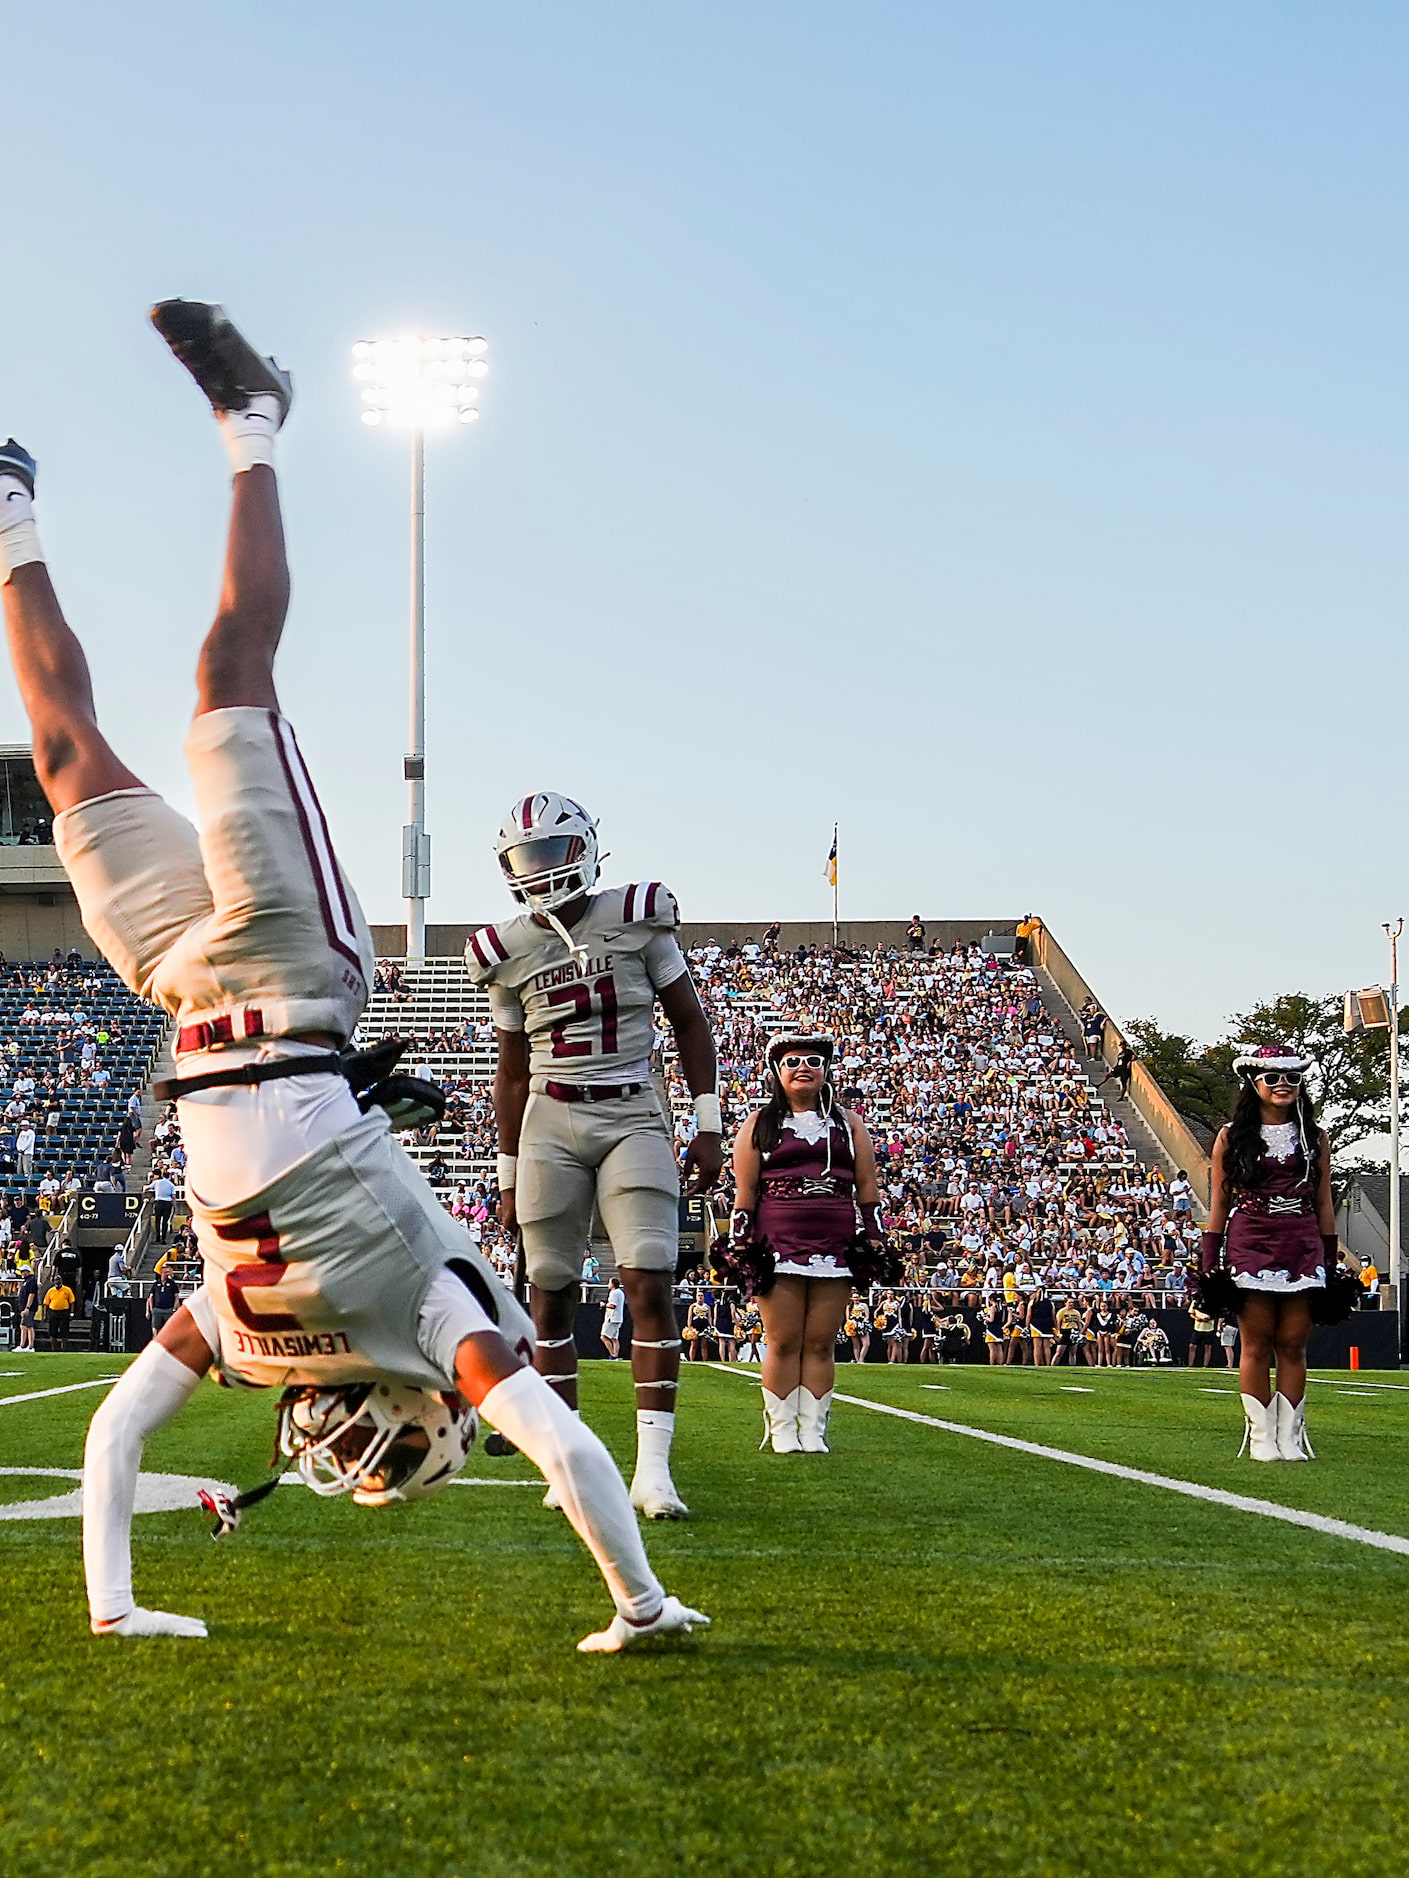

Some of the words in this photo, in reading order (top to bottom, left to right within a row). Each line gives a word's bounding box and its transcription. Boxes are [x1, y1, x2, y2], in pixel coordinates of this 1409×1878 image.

[534, 954, 614, 991] LEWISVILLE
[547, 975, 619, 1058] 21
[81, 1196, 96, 1211] C
[125, 1196, 139, 1210] D
[688, 1199, 701, 1213] E
[233, 1330, 352, 1357] LEWISVILLE
